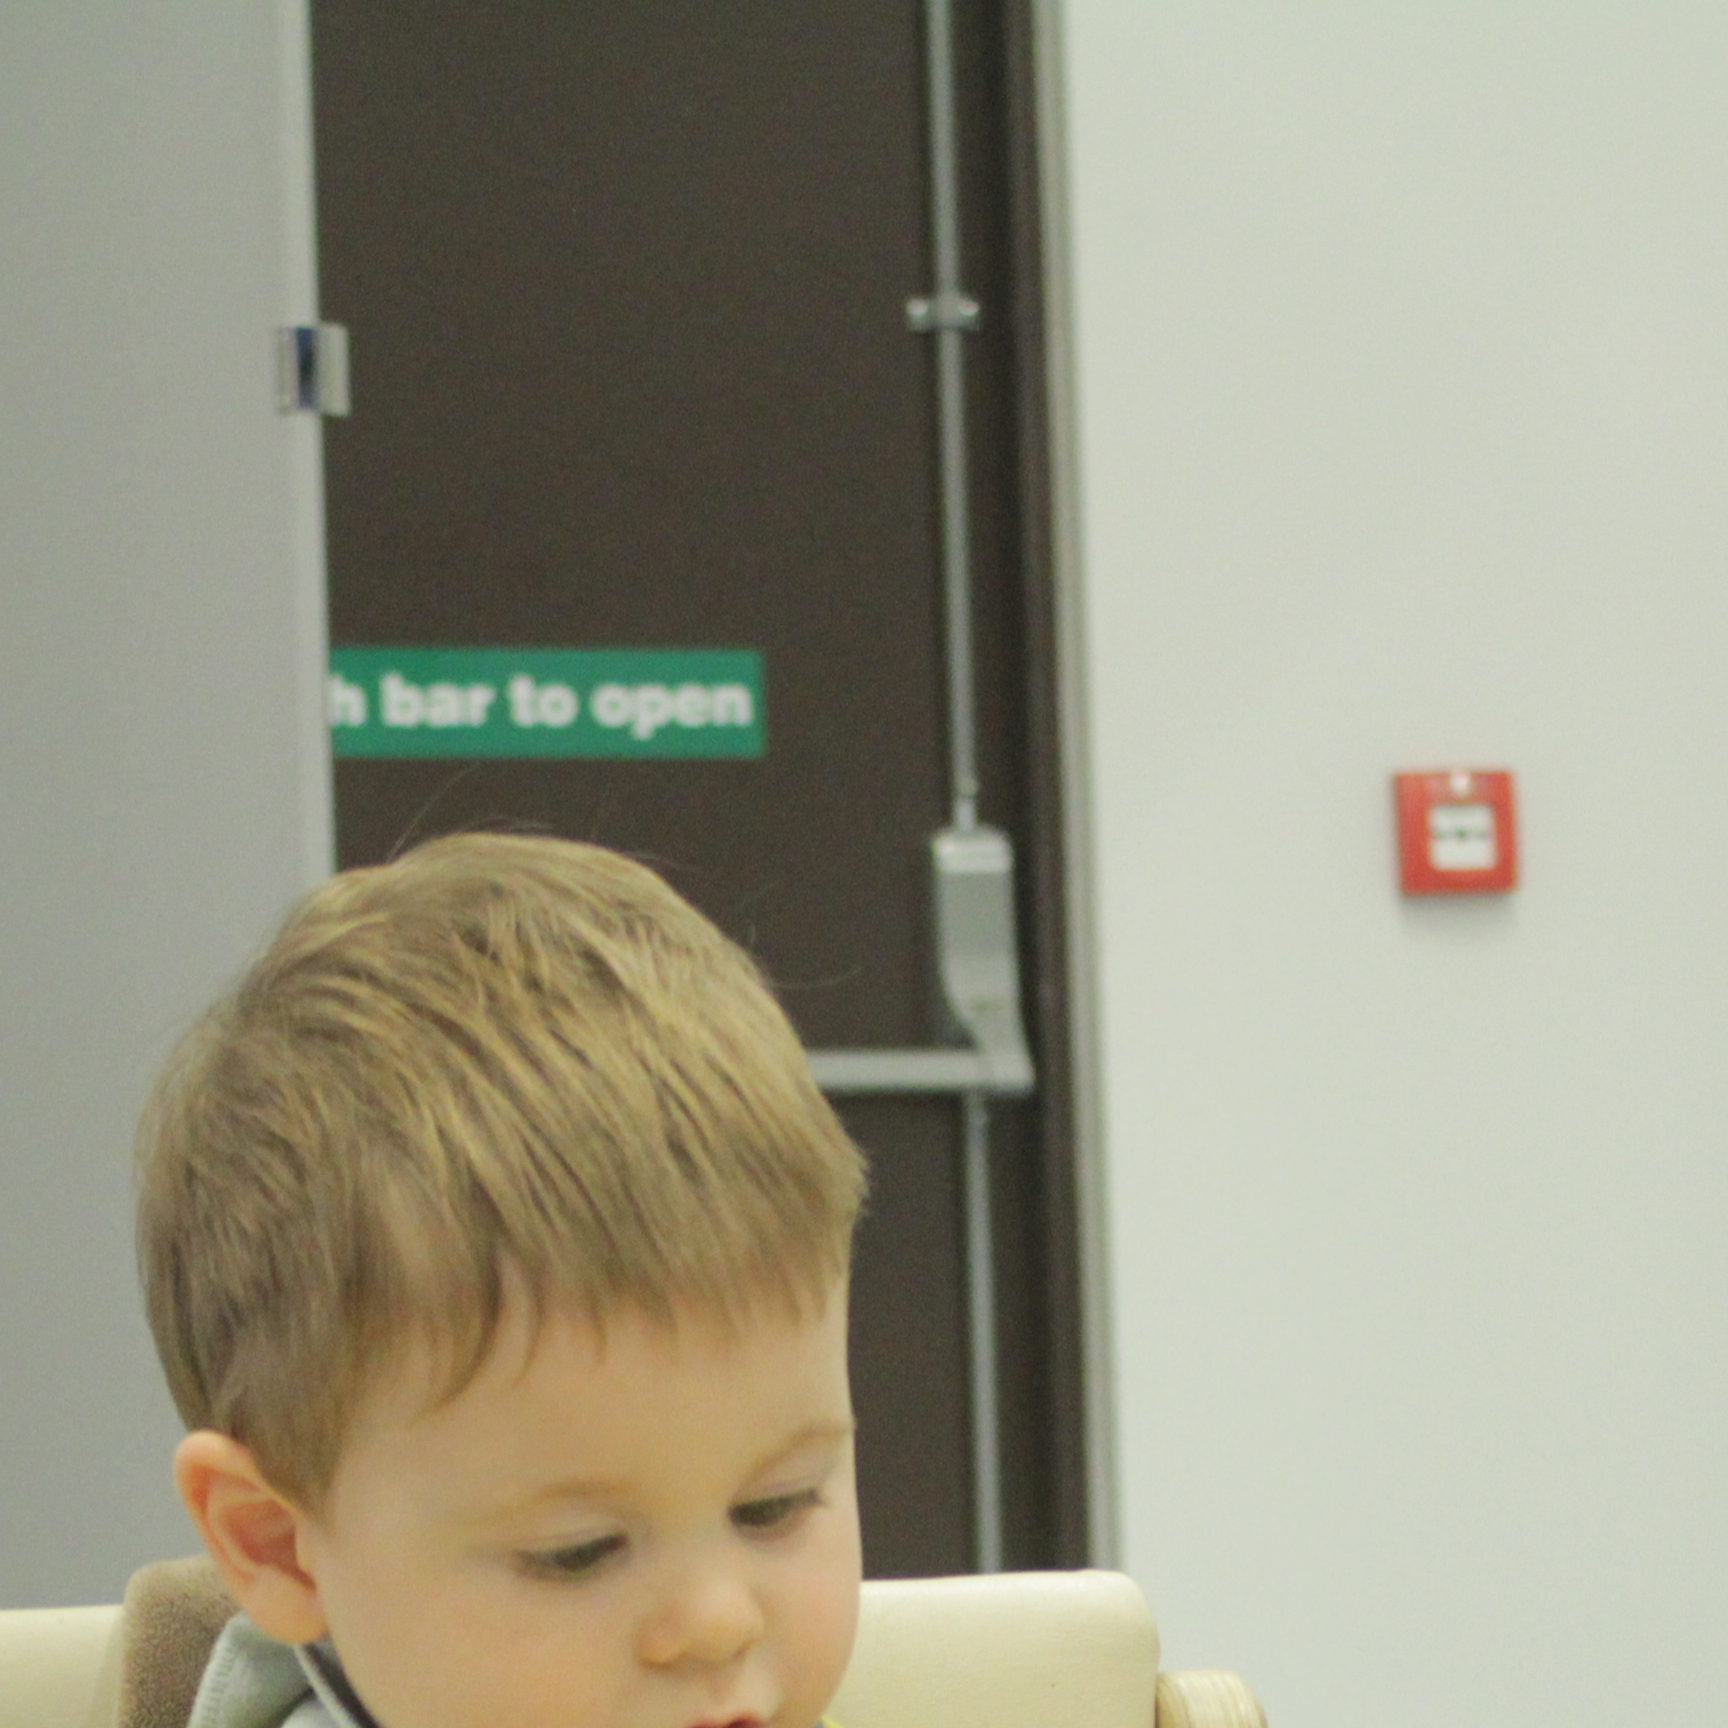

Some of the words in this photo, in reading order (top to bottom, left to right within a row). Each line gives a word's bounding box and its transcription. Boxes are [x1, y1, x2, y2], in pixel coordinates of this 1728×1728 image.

[380, 673, 494, 727] bar
[508, 674, 578, 727] to
[591, 683, 754, 740] open
